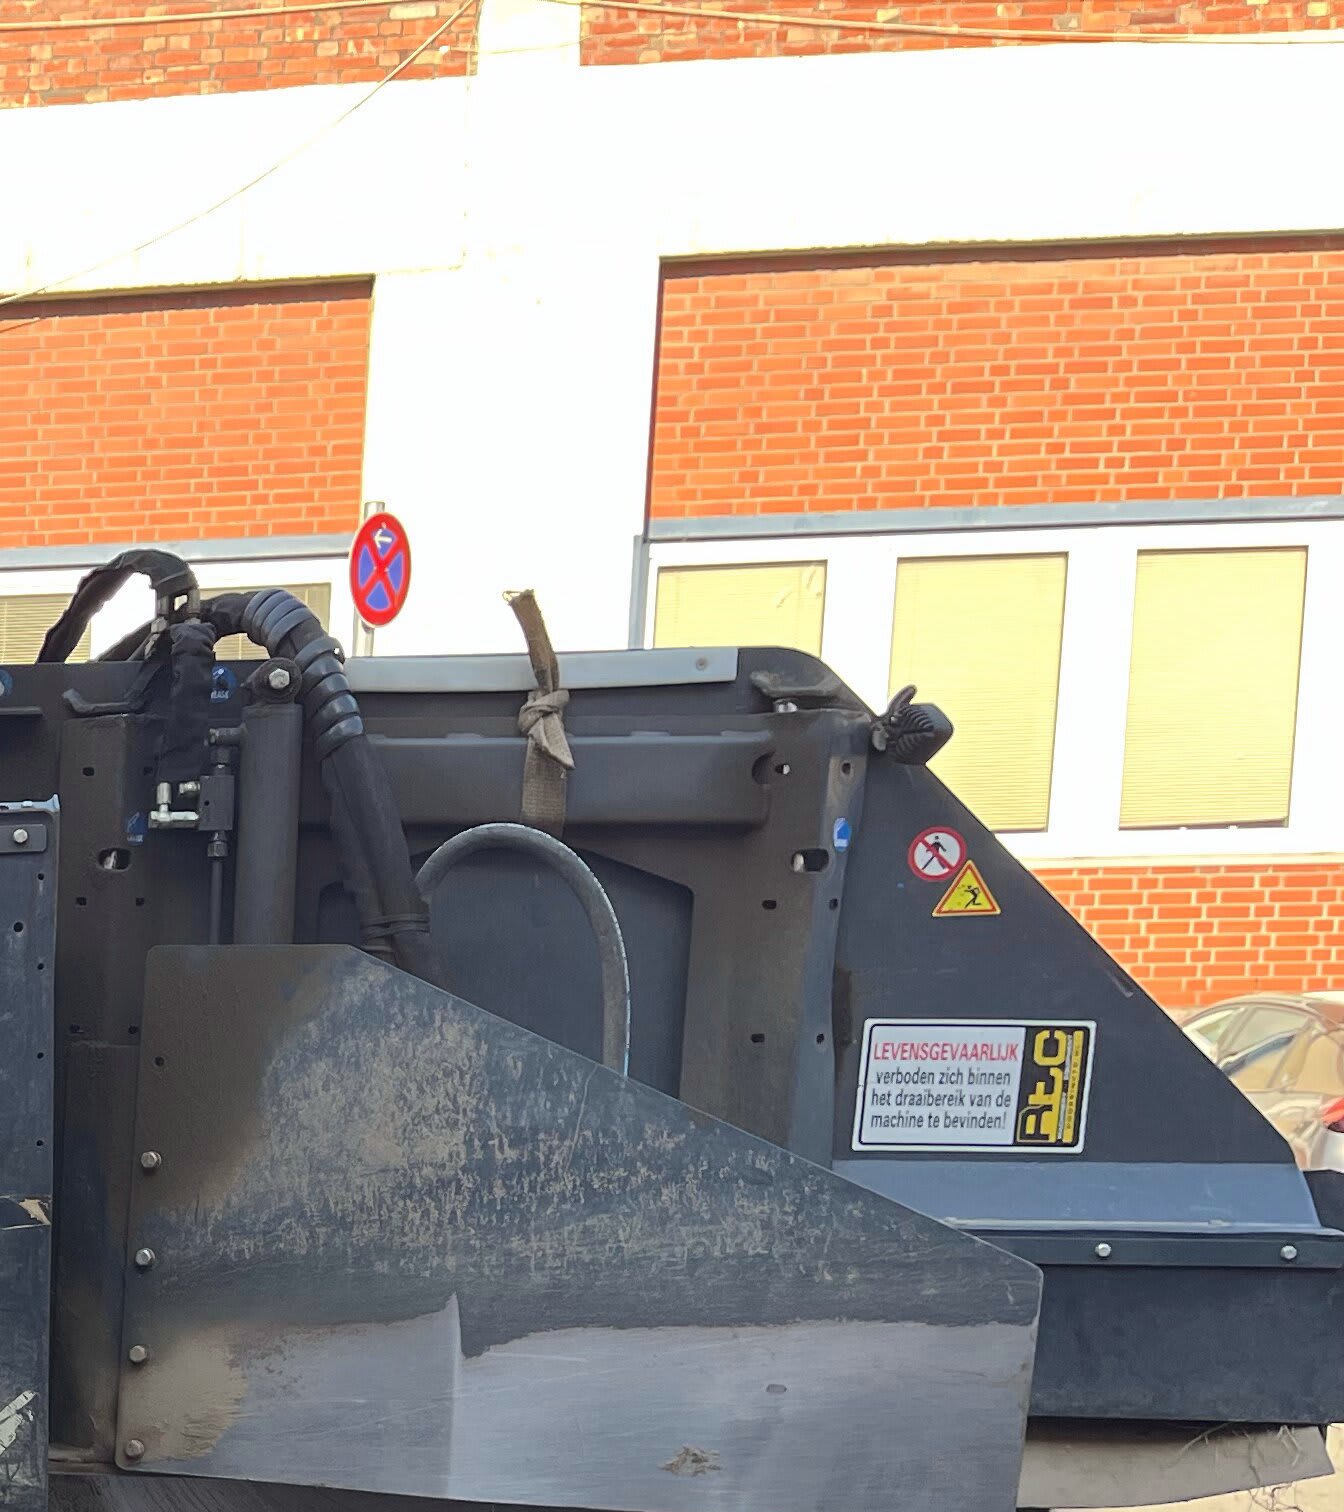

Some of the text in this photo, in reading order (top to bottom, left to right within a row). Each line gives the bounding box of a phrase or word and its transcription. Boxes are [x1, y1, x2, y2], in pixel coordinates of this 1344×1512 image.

[873, 1042, 1020, 1061] LEVENSGEVAARLIJK
[876, 1066, 1011, 1085] verboden zich binnen
[870, 1088, 1012, 1108] het draaibereik van de
[870, 1110, 1007, 1130] machine te bevinden!
